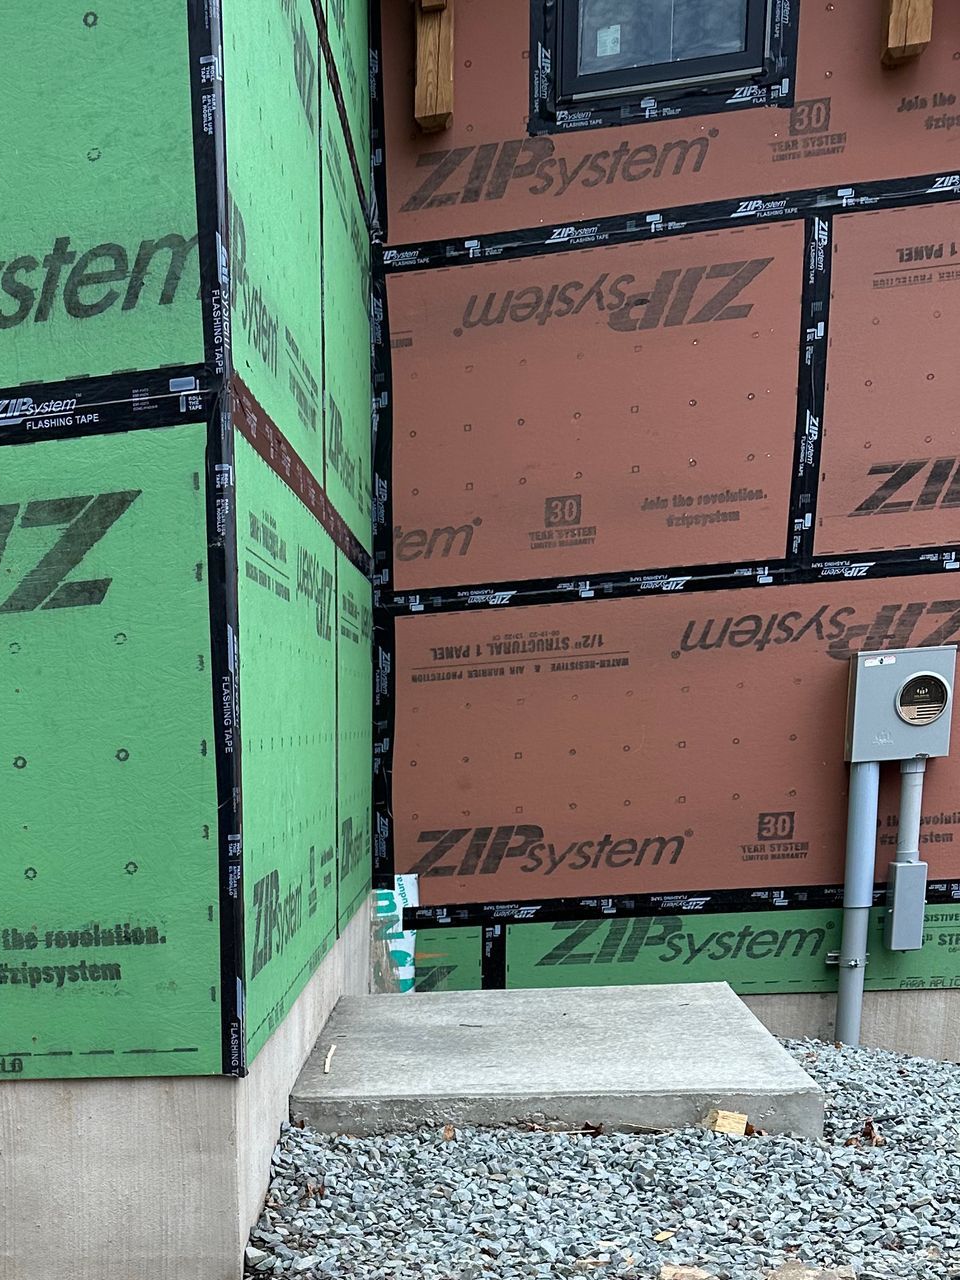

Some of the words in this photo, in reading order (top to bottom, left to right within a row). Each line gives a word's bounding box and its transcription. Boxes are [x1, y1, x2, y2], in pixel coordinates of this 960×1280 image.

[897, 96, 928, 112] Join
[932, 92, 956, 108] the
[794, 101, 828, 132] 30
[772, 139, 799, 152] YEAR
[804, 132, 847, 148] SYSTEM
[399, 135, 709, 213] ZIPsystem
[756, 210, 783, 218] FLASHING
[569, 236, 595, 245] FLASHING
[896, 243, 944, 263] PANEL
[462, 257, 775, 333] ZIPsystem
[211, 289, 223, 344] FLASHING
[214, 344, 224, 374] TAPE
[26, 416, 73, 431] FLASHING
[74, 413, 100, 426] TAPE
[640, 497, 668, 512] Join
[672, 494, 693, 508] the
[697, 488, 768, 506] revolution.
[548, 498, 579, 524] 30
[528, 531, 552, 541] YEAR
[556, 526, 596, 538] SYSTEM
[475, 645, 482, 657] 1
[487, 636, 570, 656] STRUCTURAL
[574, 634, 604, 650] 1/2"
[430, 644, 470, 661] PANEL
[411, 670, 463, 683] PROTECTION
[468, 667, 504, 679] BARRIER
[510, 666, 525, 674] AIR
[222, 676, 232, 732] FLASHING
[224, 732, 233, 754] TAPE
[761, 814, 790, 838] 30
[408, 824, 685, 878] ZIPsystem
[741, 844, 766, 854] YEAR
[769, 842, 809, 852] SYSTEM
[2, 927, 38, 951] the
[44, 922, 167, 950] revolution.
[535, 915, 825, 966] ZIPsystem
[230, 1022, 239, 1066] FLASHING
